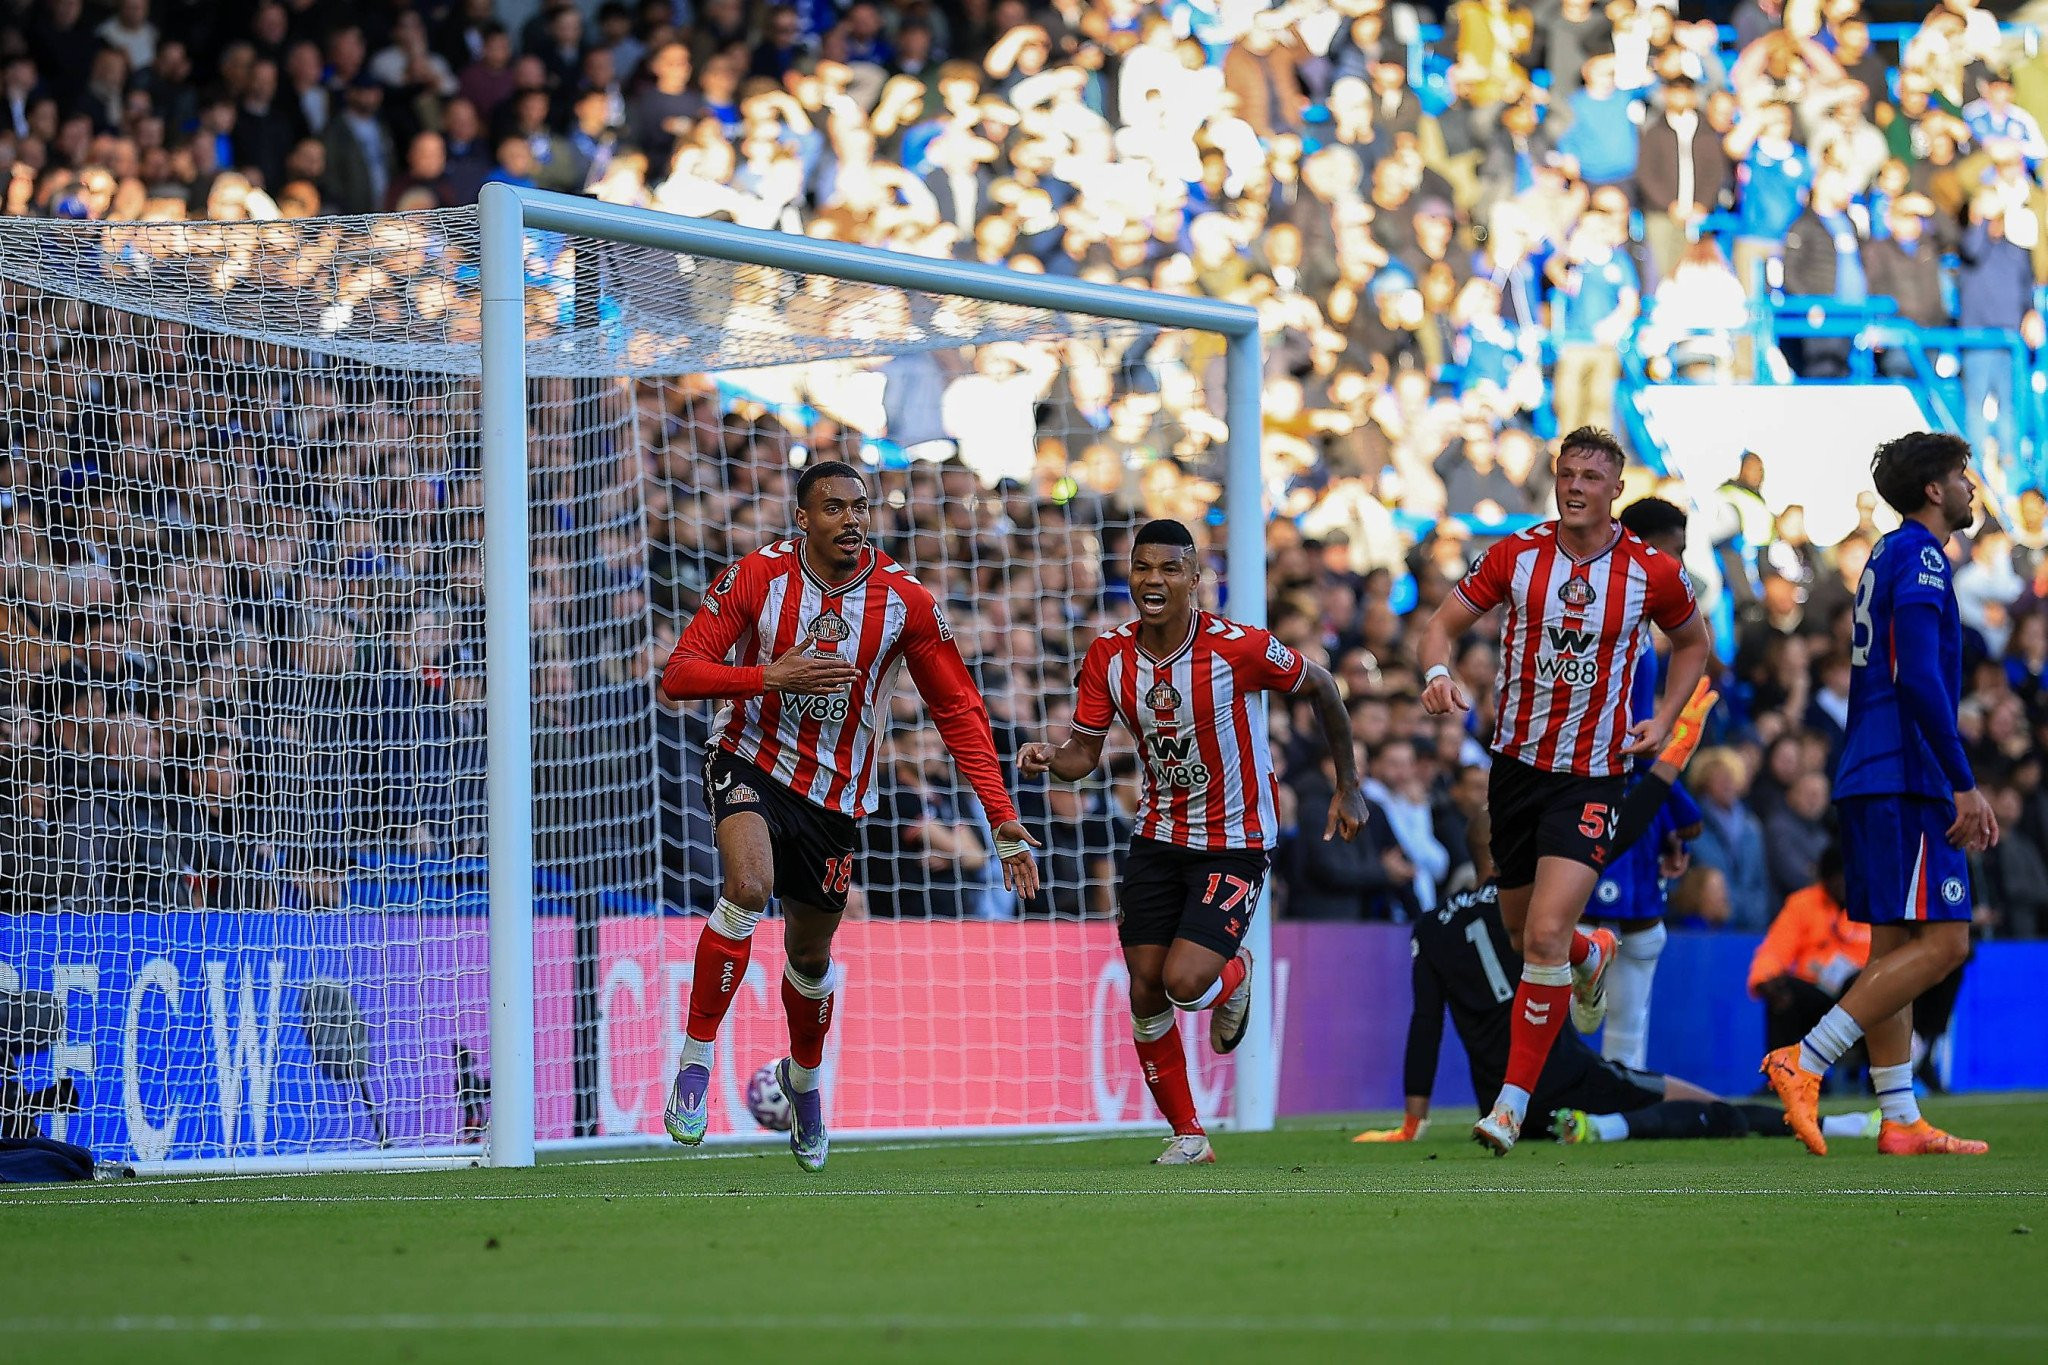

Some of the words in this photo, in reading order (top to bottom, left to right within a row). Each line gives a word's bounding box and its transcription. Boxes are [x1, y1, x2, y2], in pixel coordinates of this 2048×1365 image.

[1535, 655, 1597, 684] W88
[780, 691, 849, 721] W88
[1149, 762, 1210, 789] W88
[1578, 803, 1607, 839] 5
[822, 853, 854, 893] 18
[1202, 872, 1250, 912] 17
[721, 961, 734, 993] SAFC
[1464, 917, 1514, 1003] 1
[0, 958, 286, 1163] FCW
